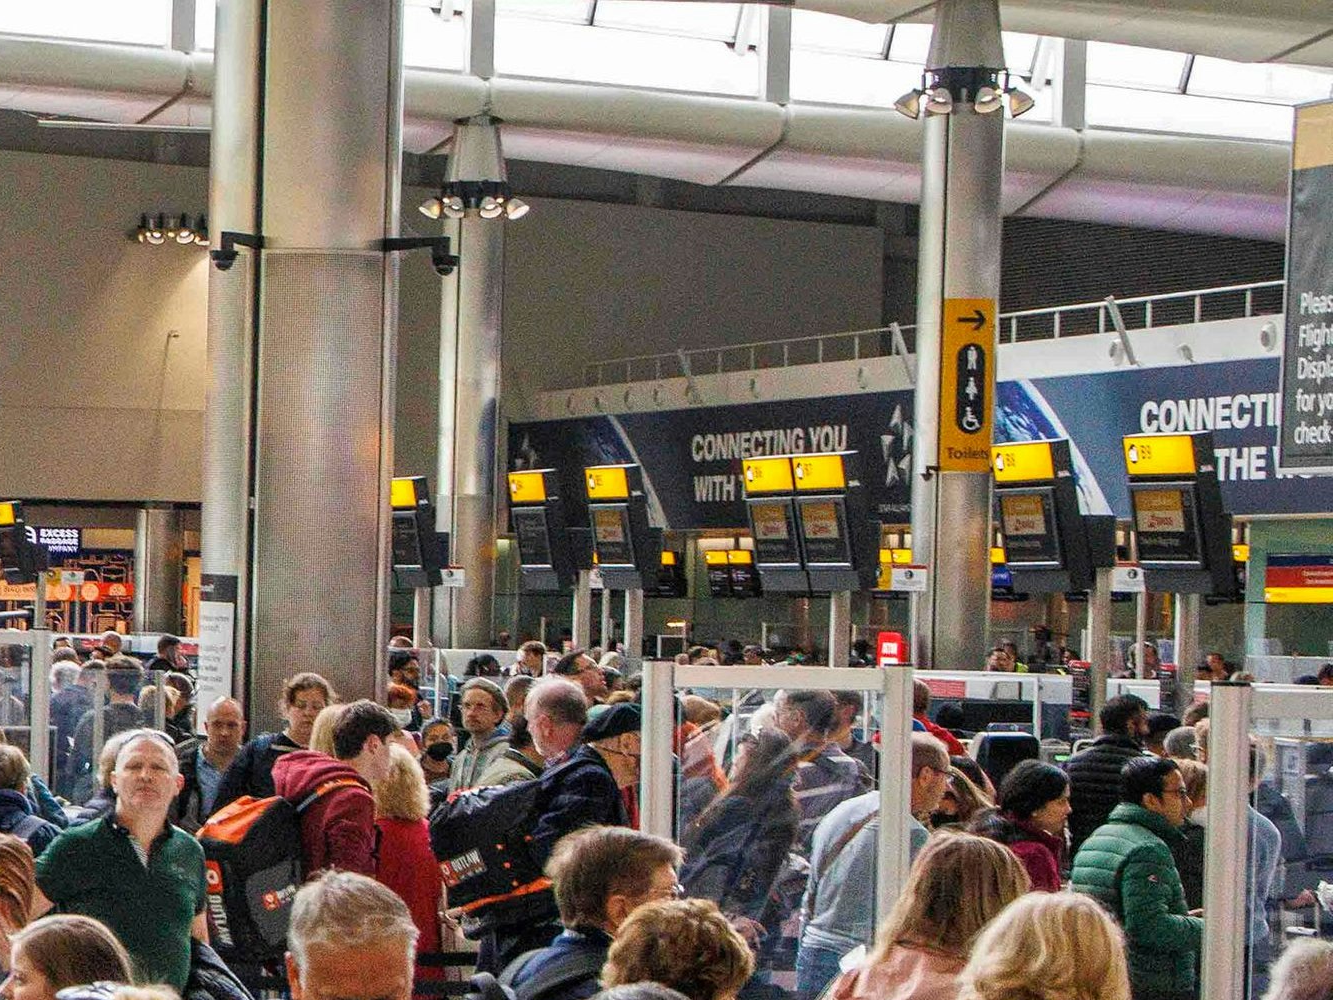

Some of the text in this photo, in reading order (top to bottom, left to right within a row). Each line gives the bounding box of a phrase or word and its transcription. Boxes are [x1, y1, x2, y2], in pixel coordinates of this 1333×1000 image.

[1296, 388, 1316, 412] for
[692, 425, 848, 463] CONNECTING YOU
[947, 447, 989, 460] Toilets
[1214, 446, 1247, 482] THE
[694, 474, 735, 502] WITH
[40, 528, 79, 538] EXCESS
[450, 848, 481, 873] OUTLAW
[207, 892, 235, 946] OUTLAW
